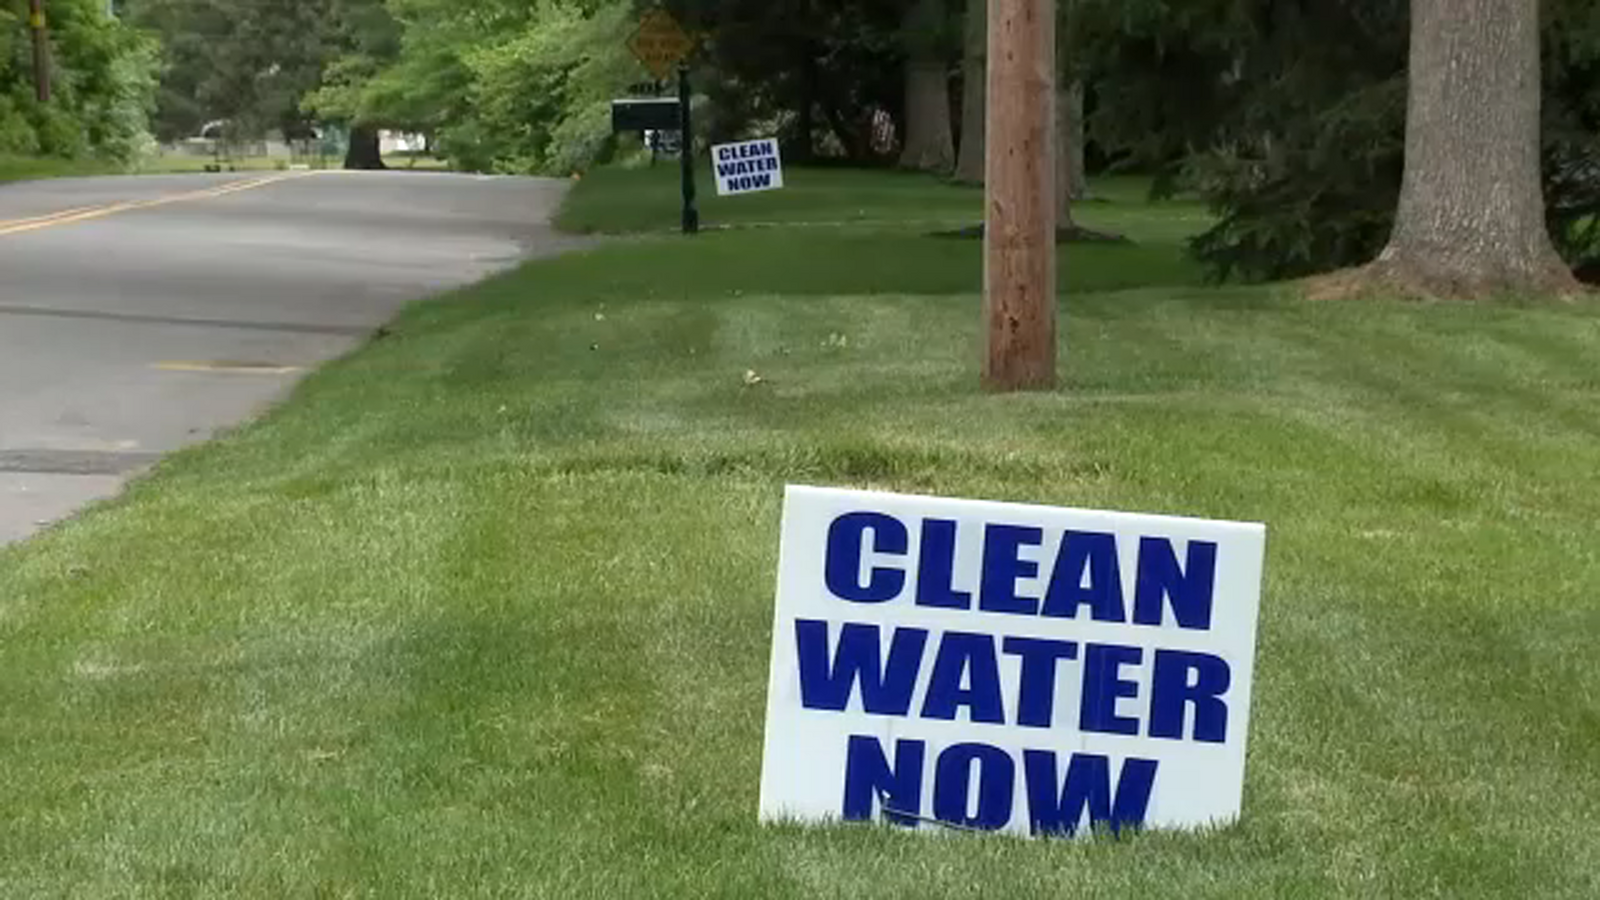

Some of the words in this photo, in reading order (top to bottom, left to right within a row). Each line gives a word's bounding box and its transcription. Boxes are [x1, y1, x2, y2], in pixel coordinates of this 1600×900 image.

[717, 157, 777, 177] WATER
[719, 142, 772, 160] CLEAN
[727, 174, 770, 191] NOW
[824, 510, 1218, 631] CLEAN
[794, 617, 1232, 743] WATER
[842, 734, 1160, 837] NOW
